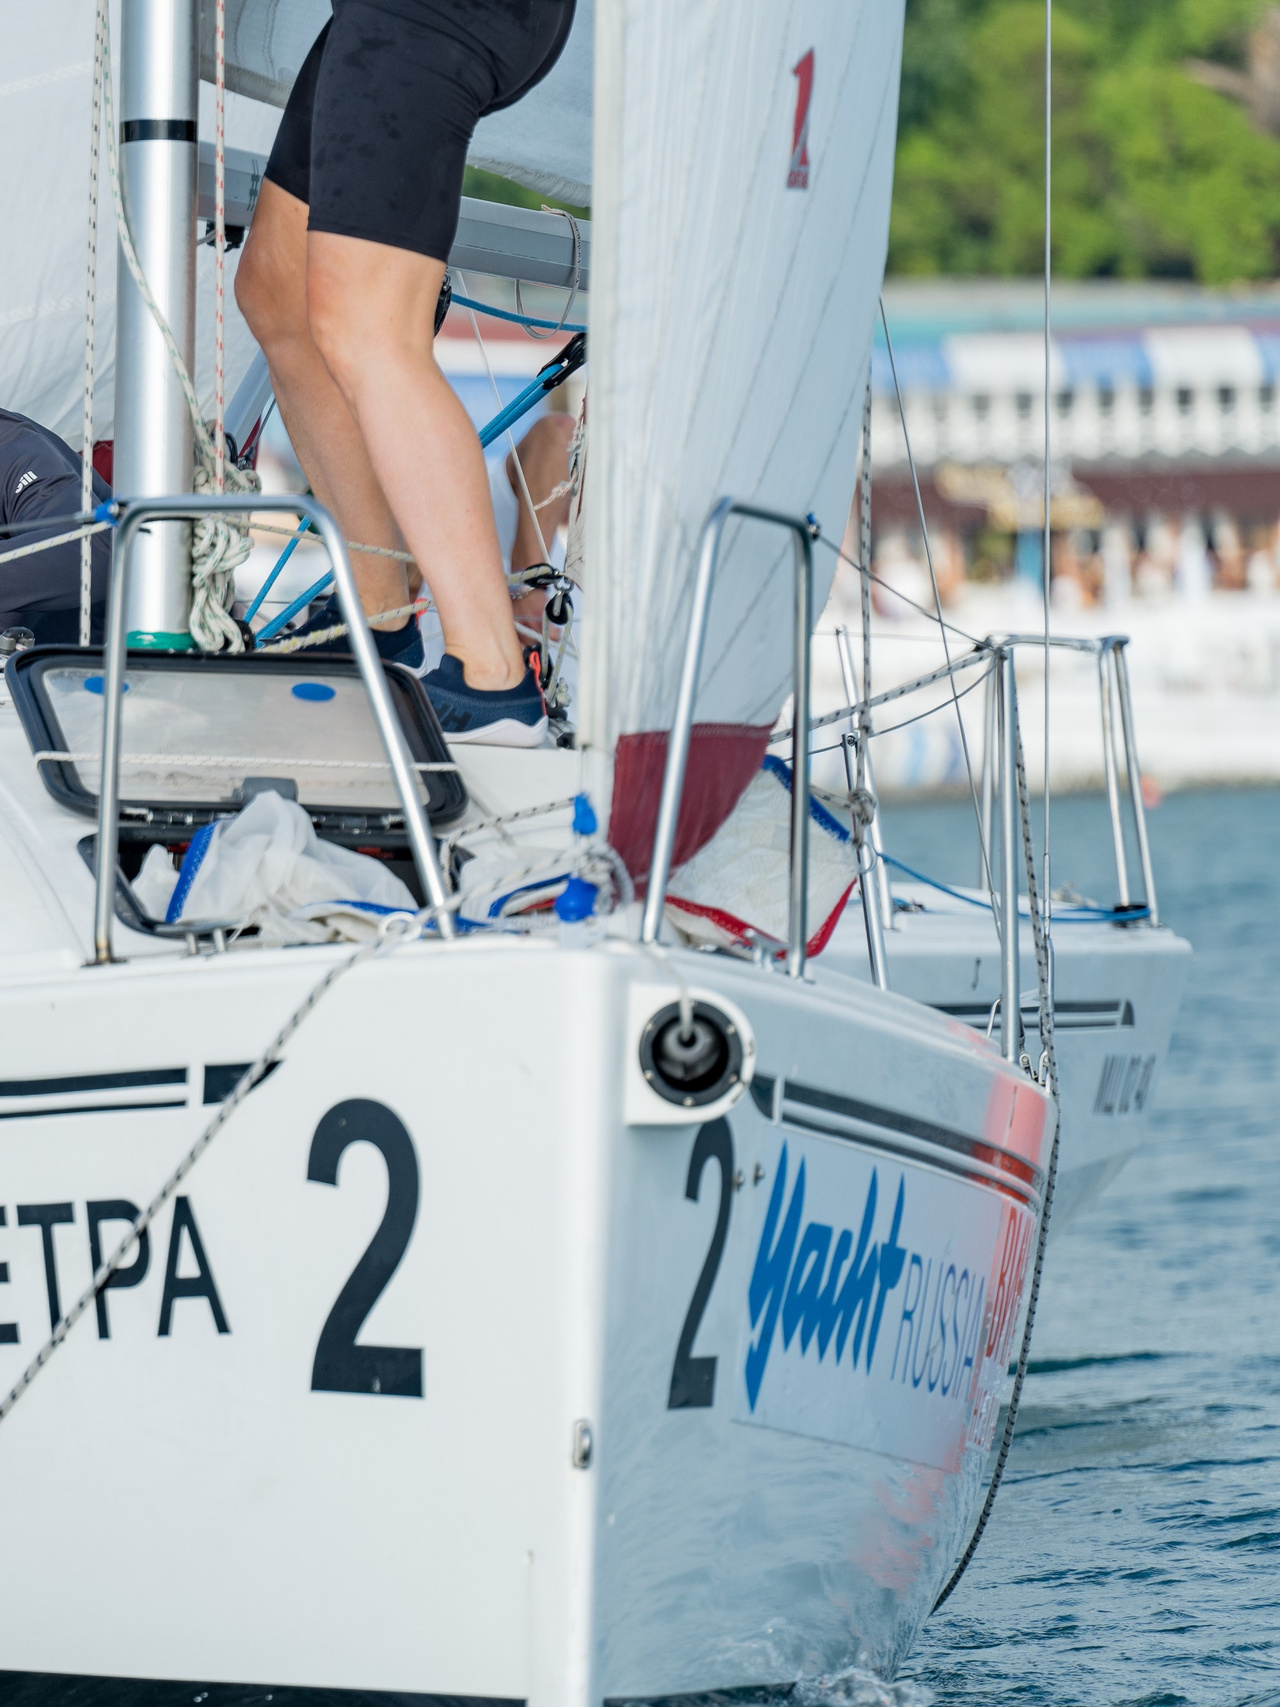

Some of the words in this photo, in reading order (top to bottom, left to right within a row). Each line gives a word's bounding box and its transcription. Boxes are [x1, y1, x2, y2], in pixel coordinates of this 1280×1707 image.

[306, 1097, 425, 1399] 2
[667, 1112, 735, 1411] 2
[889, 1252, 985, 1402] RUSSIA
